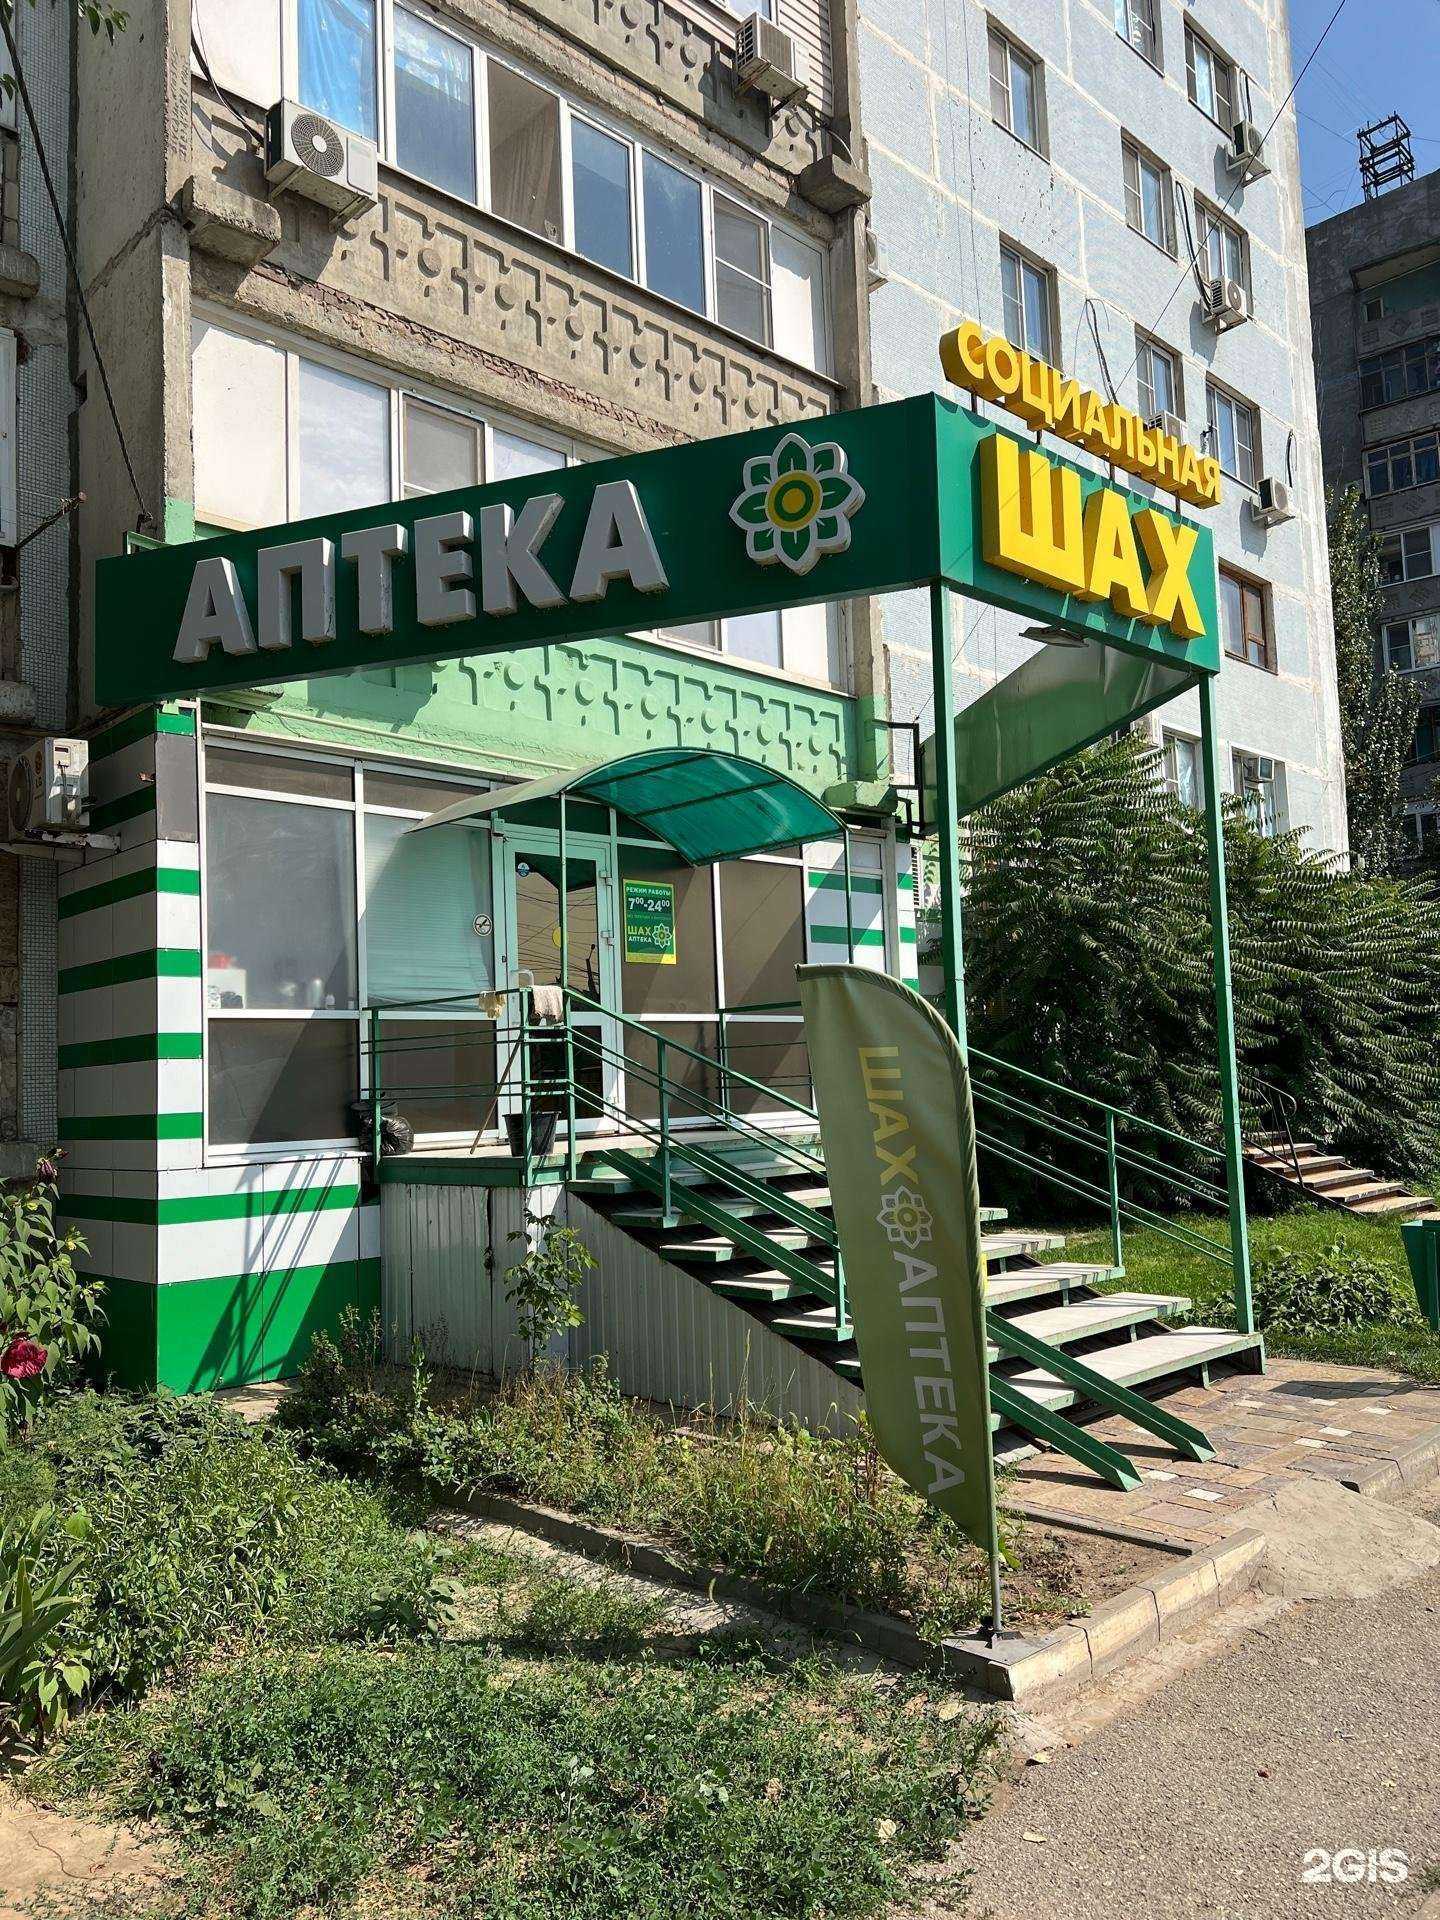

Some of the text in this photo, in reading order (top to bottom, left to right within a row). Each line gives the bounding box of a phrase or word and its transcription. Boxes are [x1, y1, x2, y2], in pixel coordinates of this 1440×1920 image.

[939, 320, 1222, 510] СОЦИАЛЬНАЯ
[172, 479, 671, 665] АПТЕКА
[981, 431, 1206, 640] ШАХ
[626, 886, 671, 896] РЕЖИМ РАБОТЫ
[627, 925, 651, 936] ШАХ
[628, 936, 652, 944] АПТЕКА
[857, 1046, 966, 1496] ШАХ АПТЕКА
